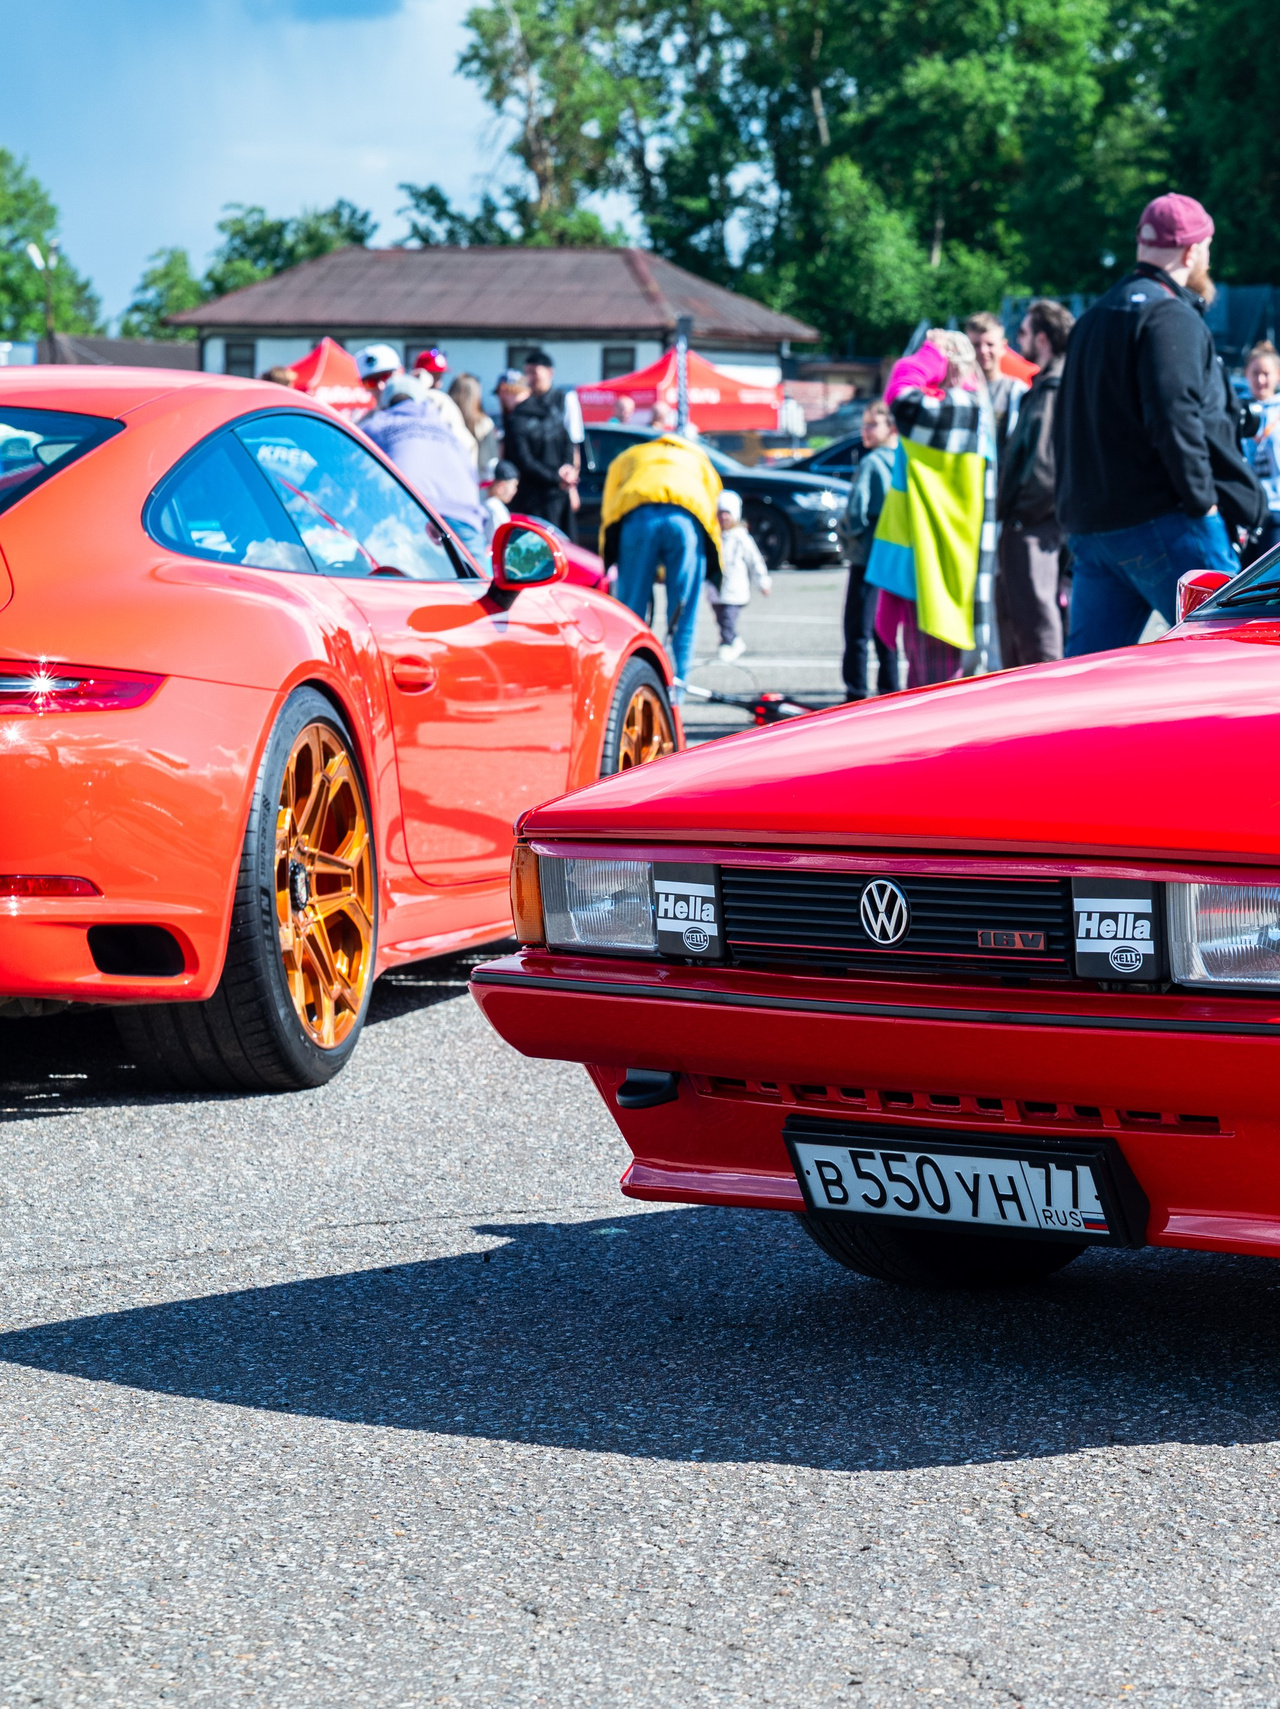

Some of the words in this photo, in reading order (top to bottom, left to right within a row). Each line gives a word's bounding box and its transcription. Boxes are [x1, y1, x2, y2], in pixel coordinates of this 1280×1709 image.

[657, 893, 715, 922] Hella
[1077, 912, 1151, 940] Hella
[686, 932, 709, 946] HELLA
[1112, 951, 1142, 964] HELLA
[1042, 1207, 1082, 1228] RUS
